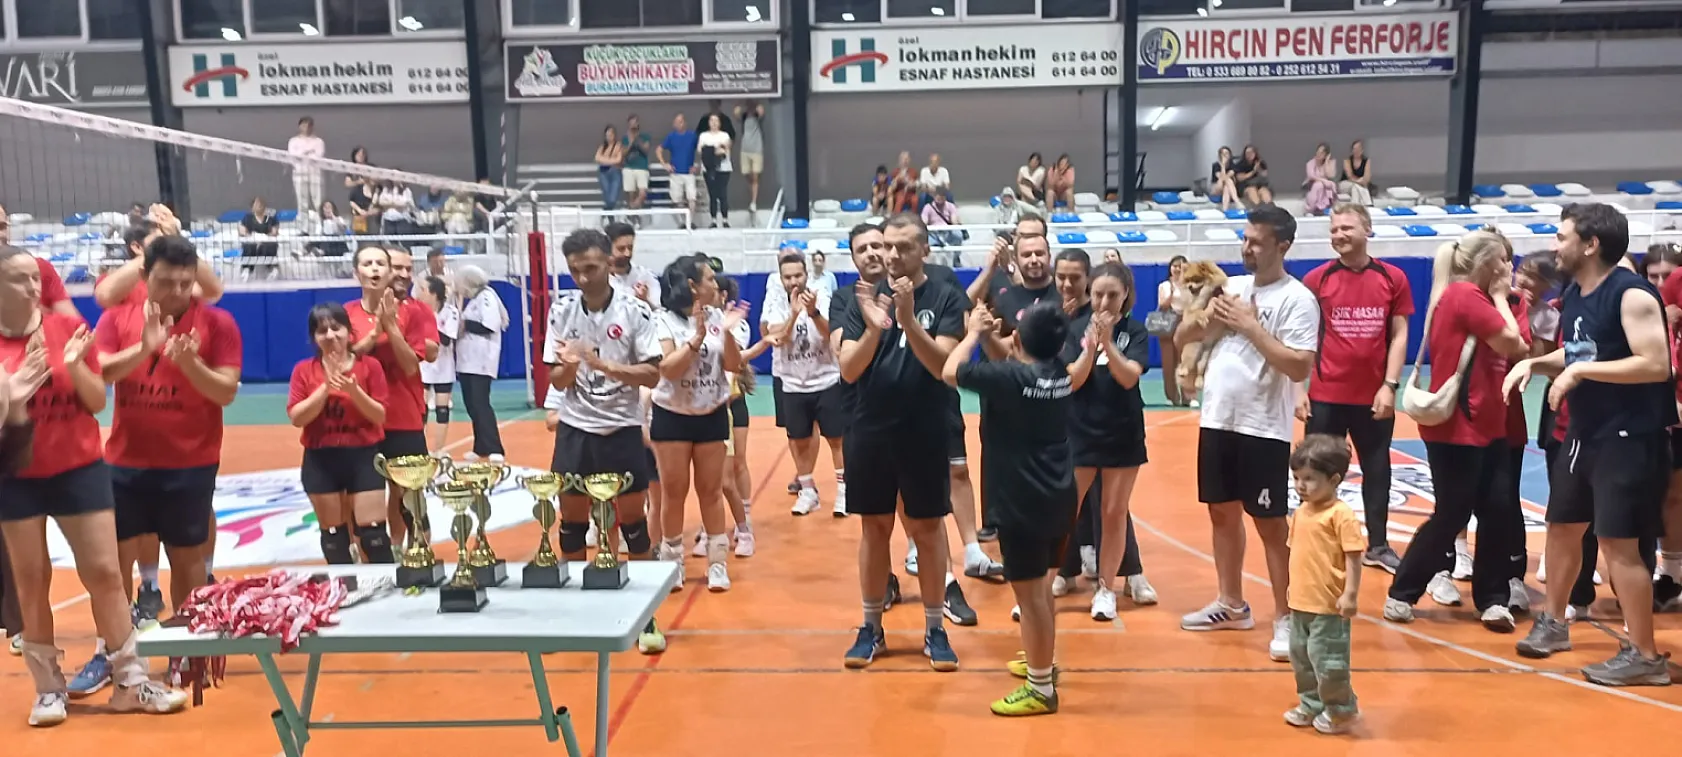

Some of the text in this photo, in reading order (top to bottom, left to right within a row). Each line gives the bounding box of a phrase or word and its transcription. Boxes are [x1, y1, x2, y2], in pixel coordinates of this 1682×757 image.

[1275, 26, 1324, 57] PEN
[1331, 21, 1449, 55] FERFORJE
[1052, 50, 1117, 62] 612 64 00
[899, 62, 1036, 81] ESNAF HASTANESİ
[1052, 65, 1117, 77] 614 64 00
[1283, 64, 1299, 75] 252
[260, 79, 393, 96] ESNAF HASTANESİ
[681, 379, 721, 389] DEMK
[1257, 487, 1272, 508] 4
